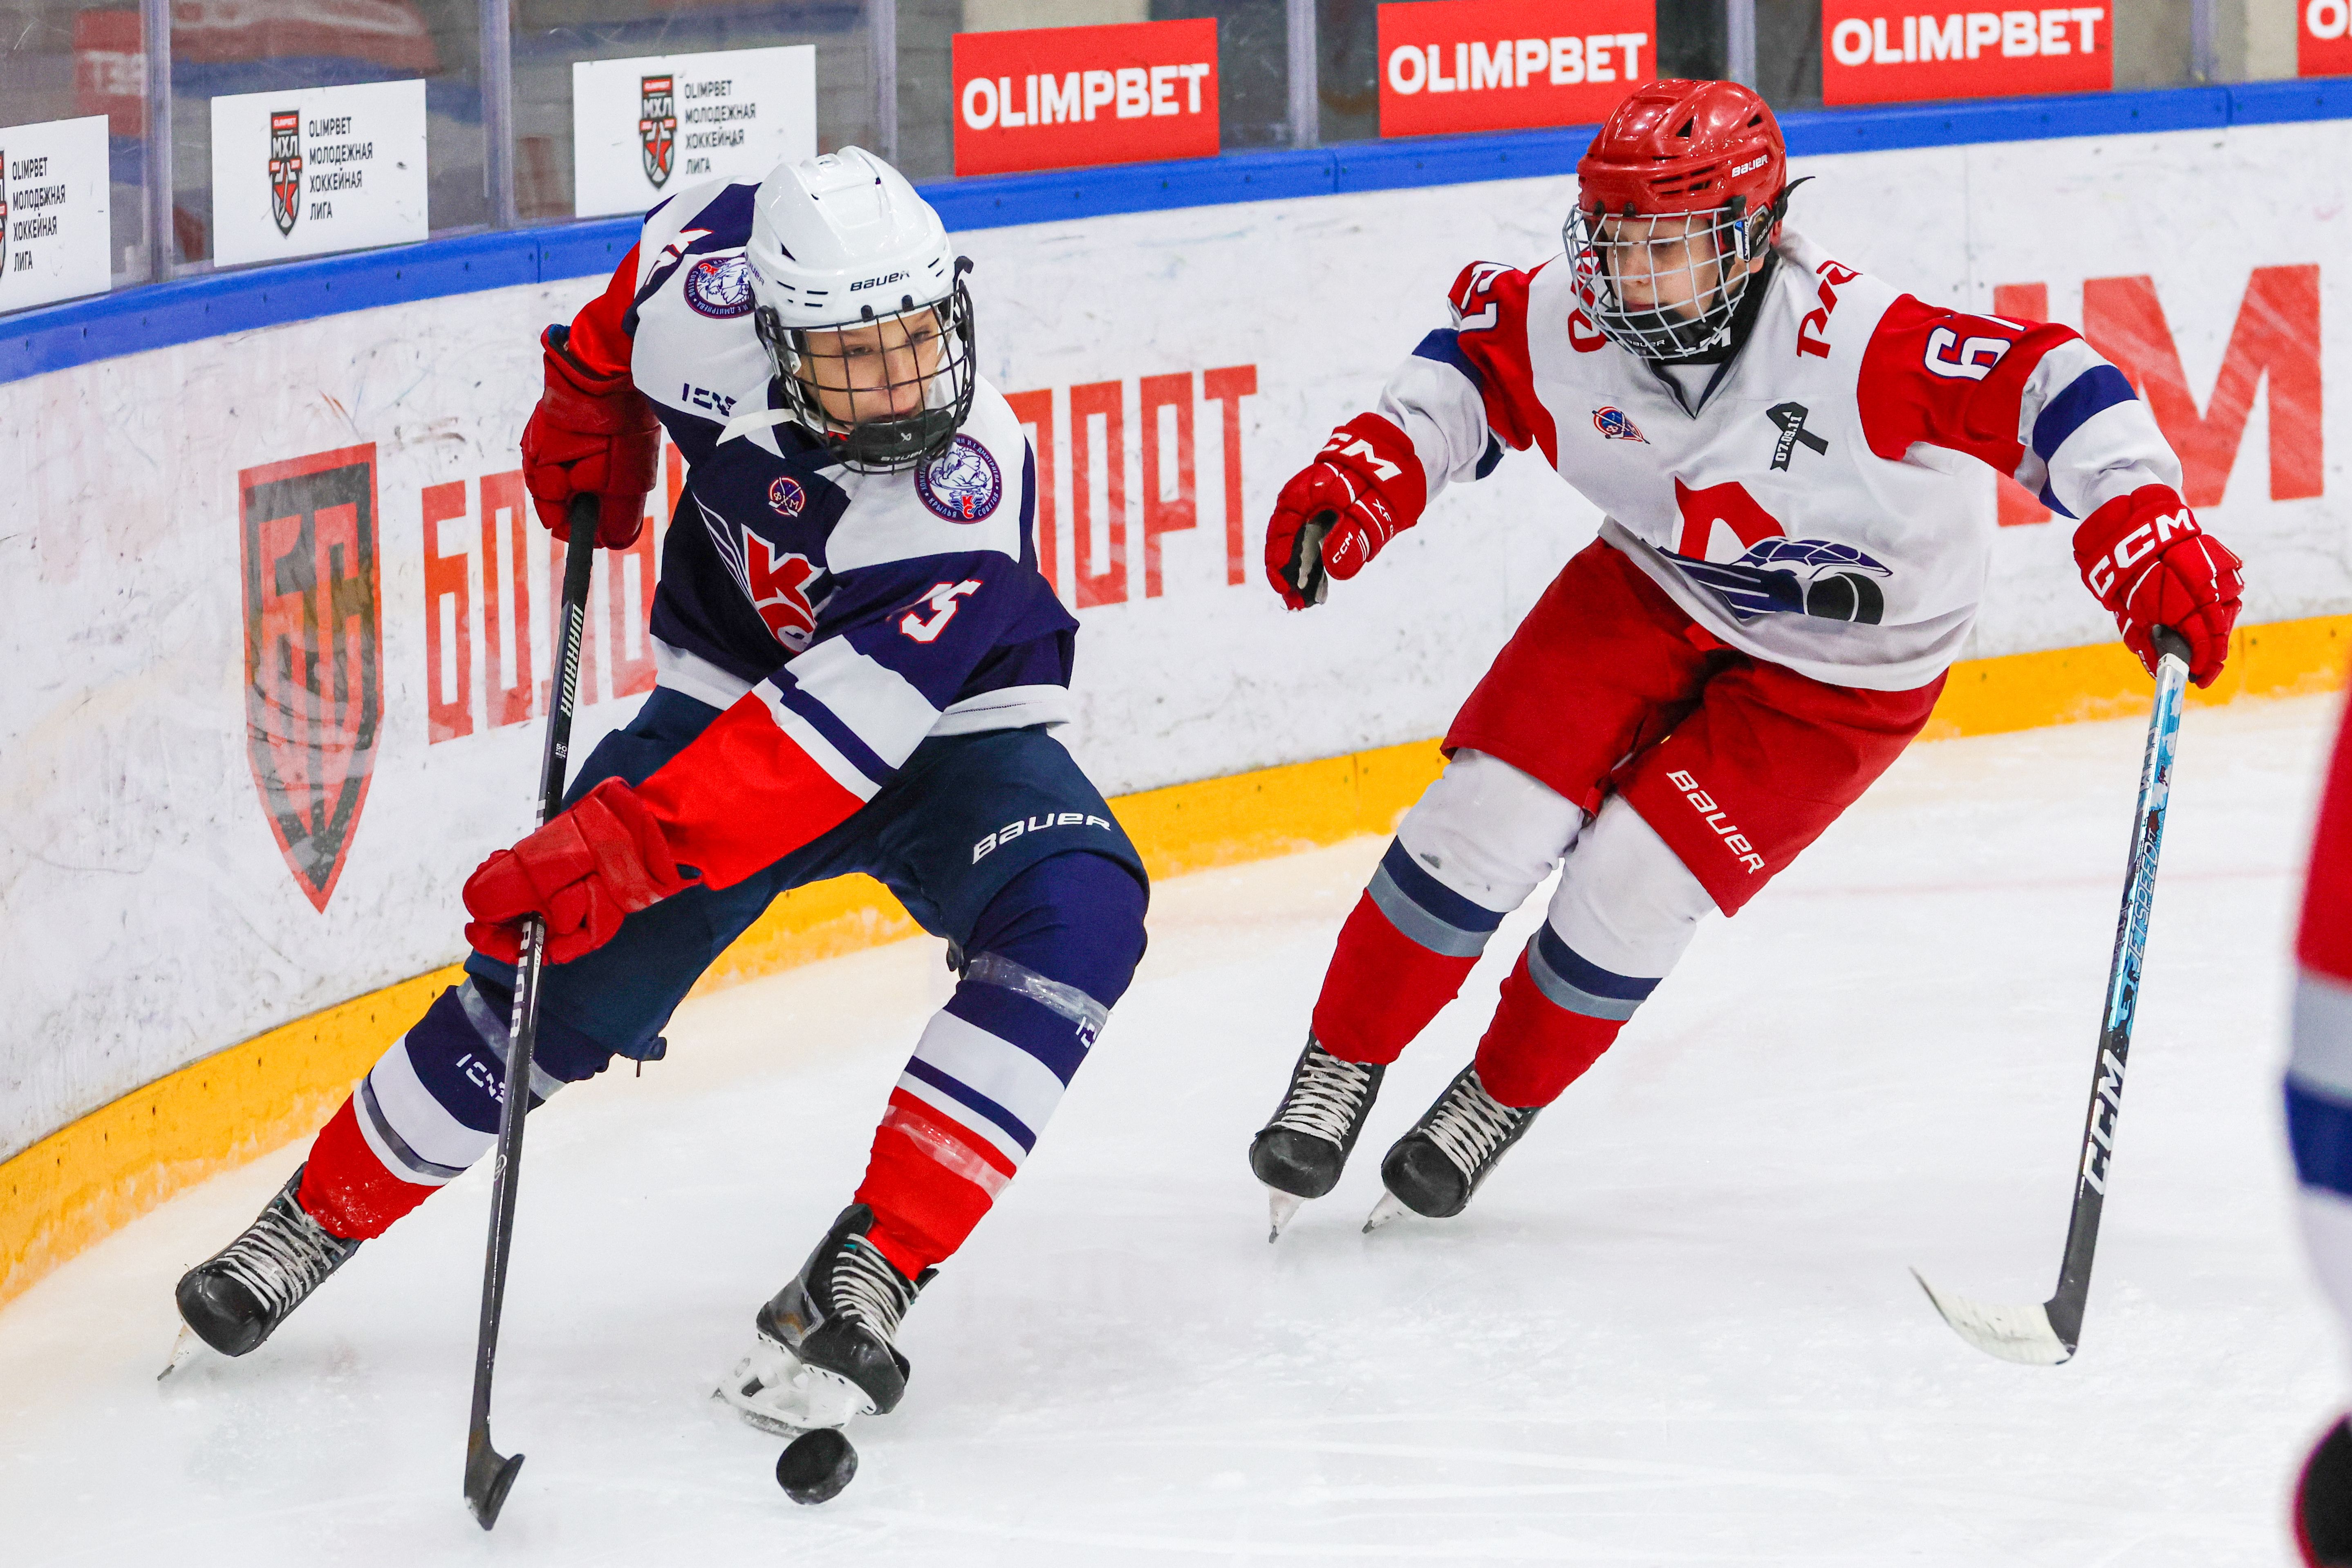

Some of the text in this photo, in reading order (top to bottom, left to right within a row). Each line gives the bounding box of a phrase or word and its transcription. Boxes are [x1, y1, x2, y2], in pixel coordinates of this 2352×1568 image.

[2306, 0, 2352, 40] O
[1831, 8, 2104, 67] OLIMPBET
[1389, 33, 1647, 94] OLIMPBET
[684, 80, 732, 99] OLIMPBET
[962, 63, 1210, 130] OLIMPBET
[643, 97, 673, 119] МХЛ
[685, 103, 756, 124] МОЛОДЕЖНАЯ
[309, 116, 352, 138] OLIMPBET
[686, 126, 744, 150] ХОККЕЙНАЯ
[272, 135, 298, 158] МХЛ
[309, 142, 373, 166] МОЛОДЕЖНАЯ
[12, 157, 48, 181] OLIMPBET
[686, 157, 711, 175] ЛИГА
[310, 167, 362, 193] ХОККЕЙНАЯ
[13, 184, 65, 211] МОЛОДЕЖНАЯ
[310, 201, 332, 220] ЛИГА
[13, 213, 57, 242] ХОККЕЙНАЯ
[14, 251, 33, 272] ЛИГА
[749, 260, 764, 286] UER
[1775, 416, 1803, 461] 07.09.11
[1002, 364, 1258, 609] ПОРТ
[928, 497, 957, 518] КРЫЛЬЯ
[977, 492, 999, 517] СОВЕТОВ
[1332, 531, 1353, 564] CCM
[2088, 508, 2195, 598] CCM
[560, 603, 584, 718] WARRIOR
[1666, 770, 1765, 874] BAUER
[972, 812, 1111, 865] BAUER
[2128, 827, 2159, 973] JETSPEED FT
[2082, 1049, 2126, 1195] CCM
